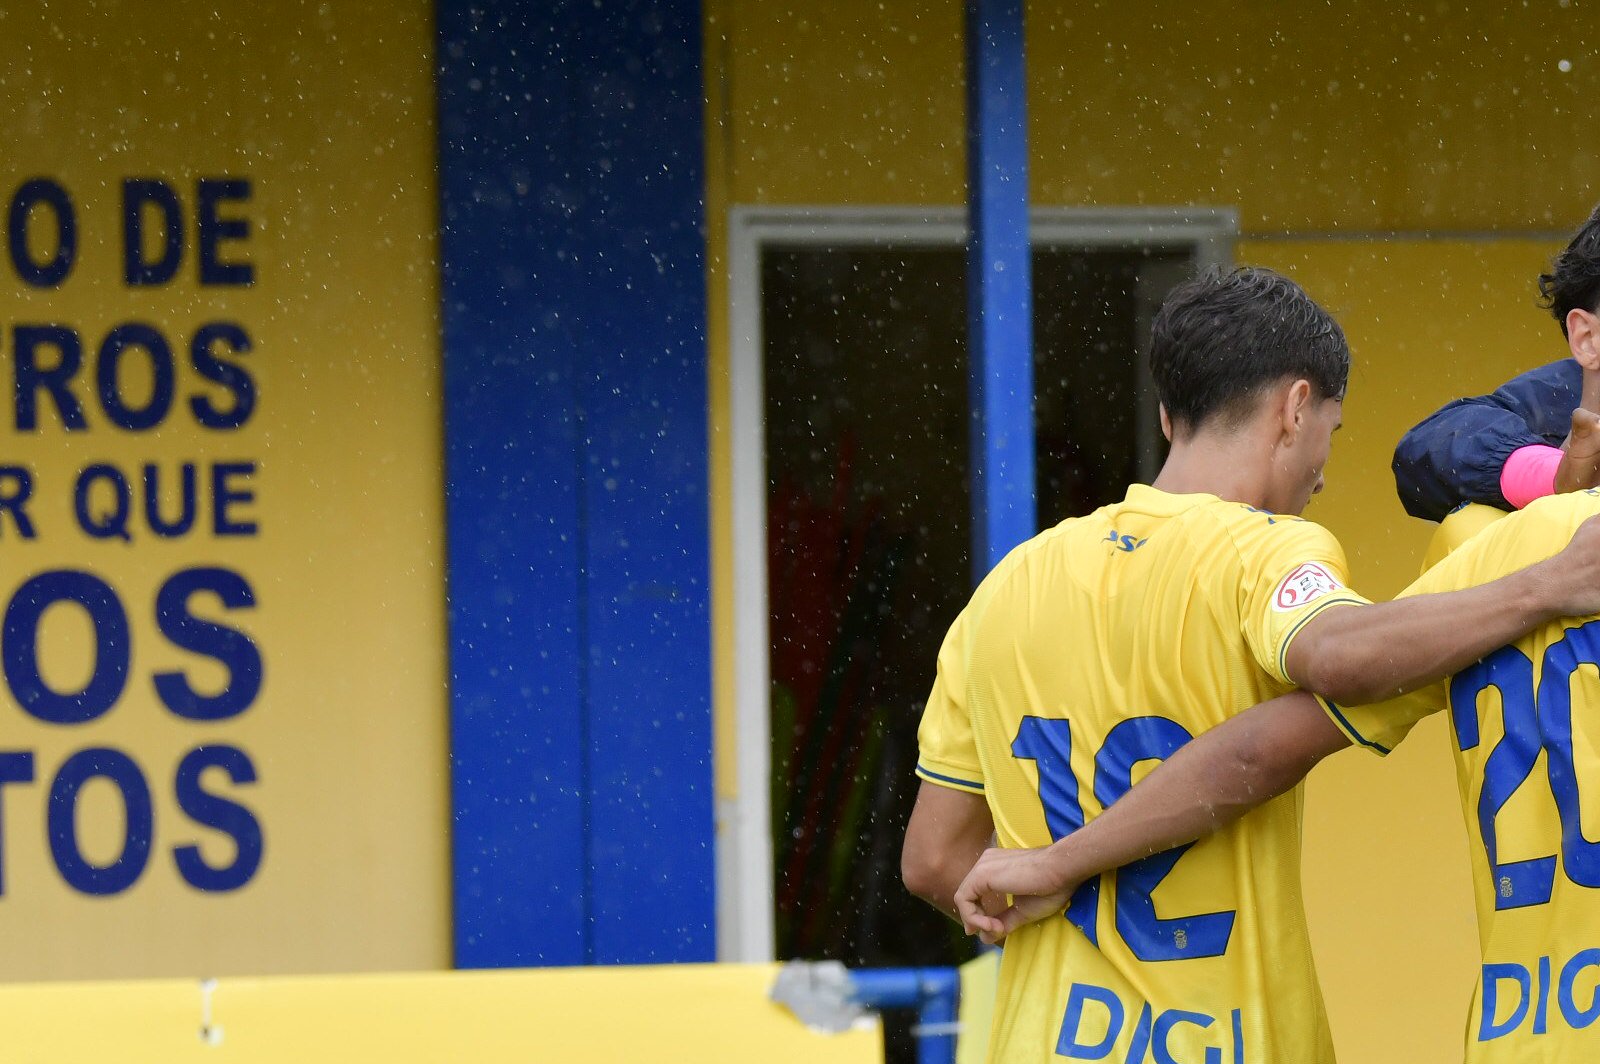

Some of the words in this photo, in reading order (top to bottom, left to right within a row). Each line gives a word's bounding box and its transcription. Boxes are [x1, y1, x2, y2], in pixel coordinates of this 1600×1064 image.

[8, 177, 78, 289] O
[122, 177, 257, 289] DE
[74, 461, 261, 544] QUE
[1010, 714, 1238, 963] 12
